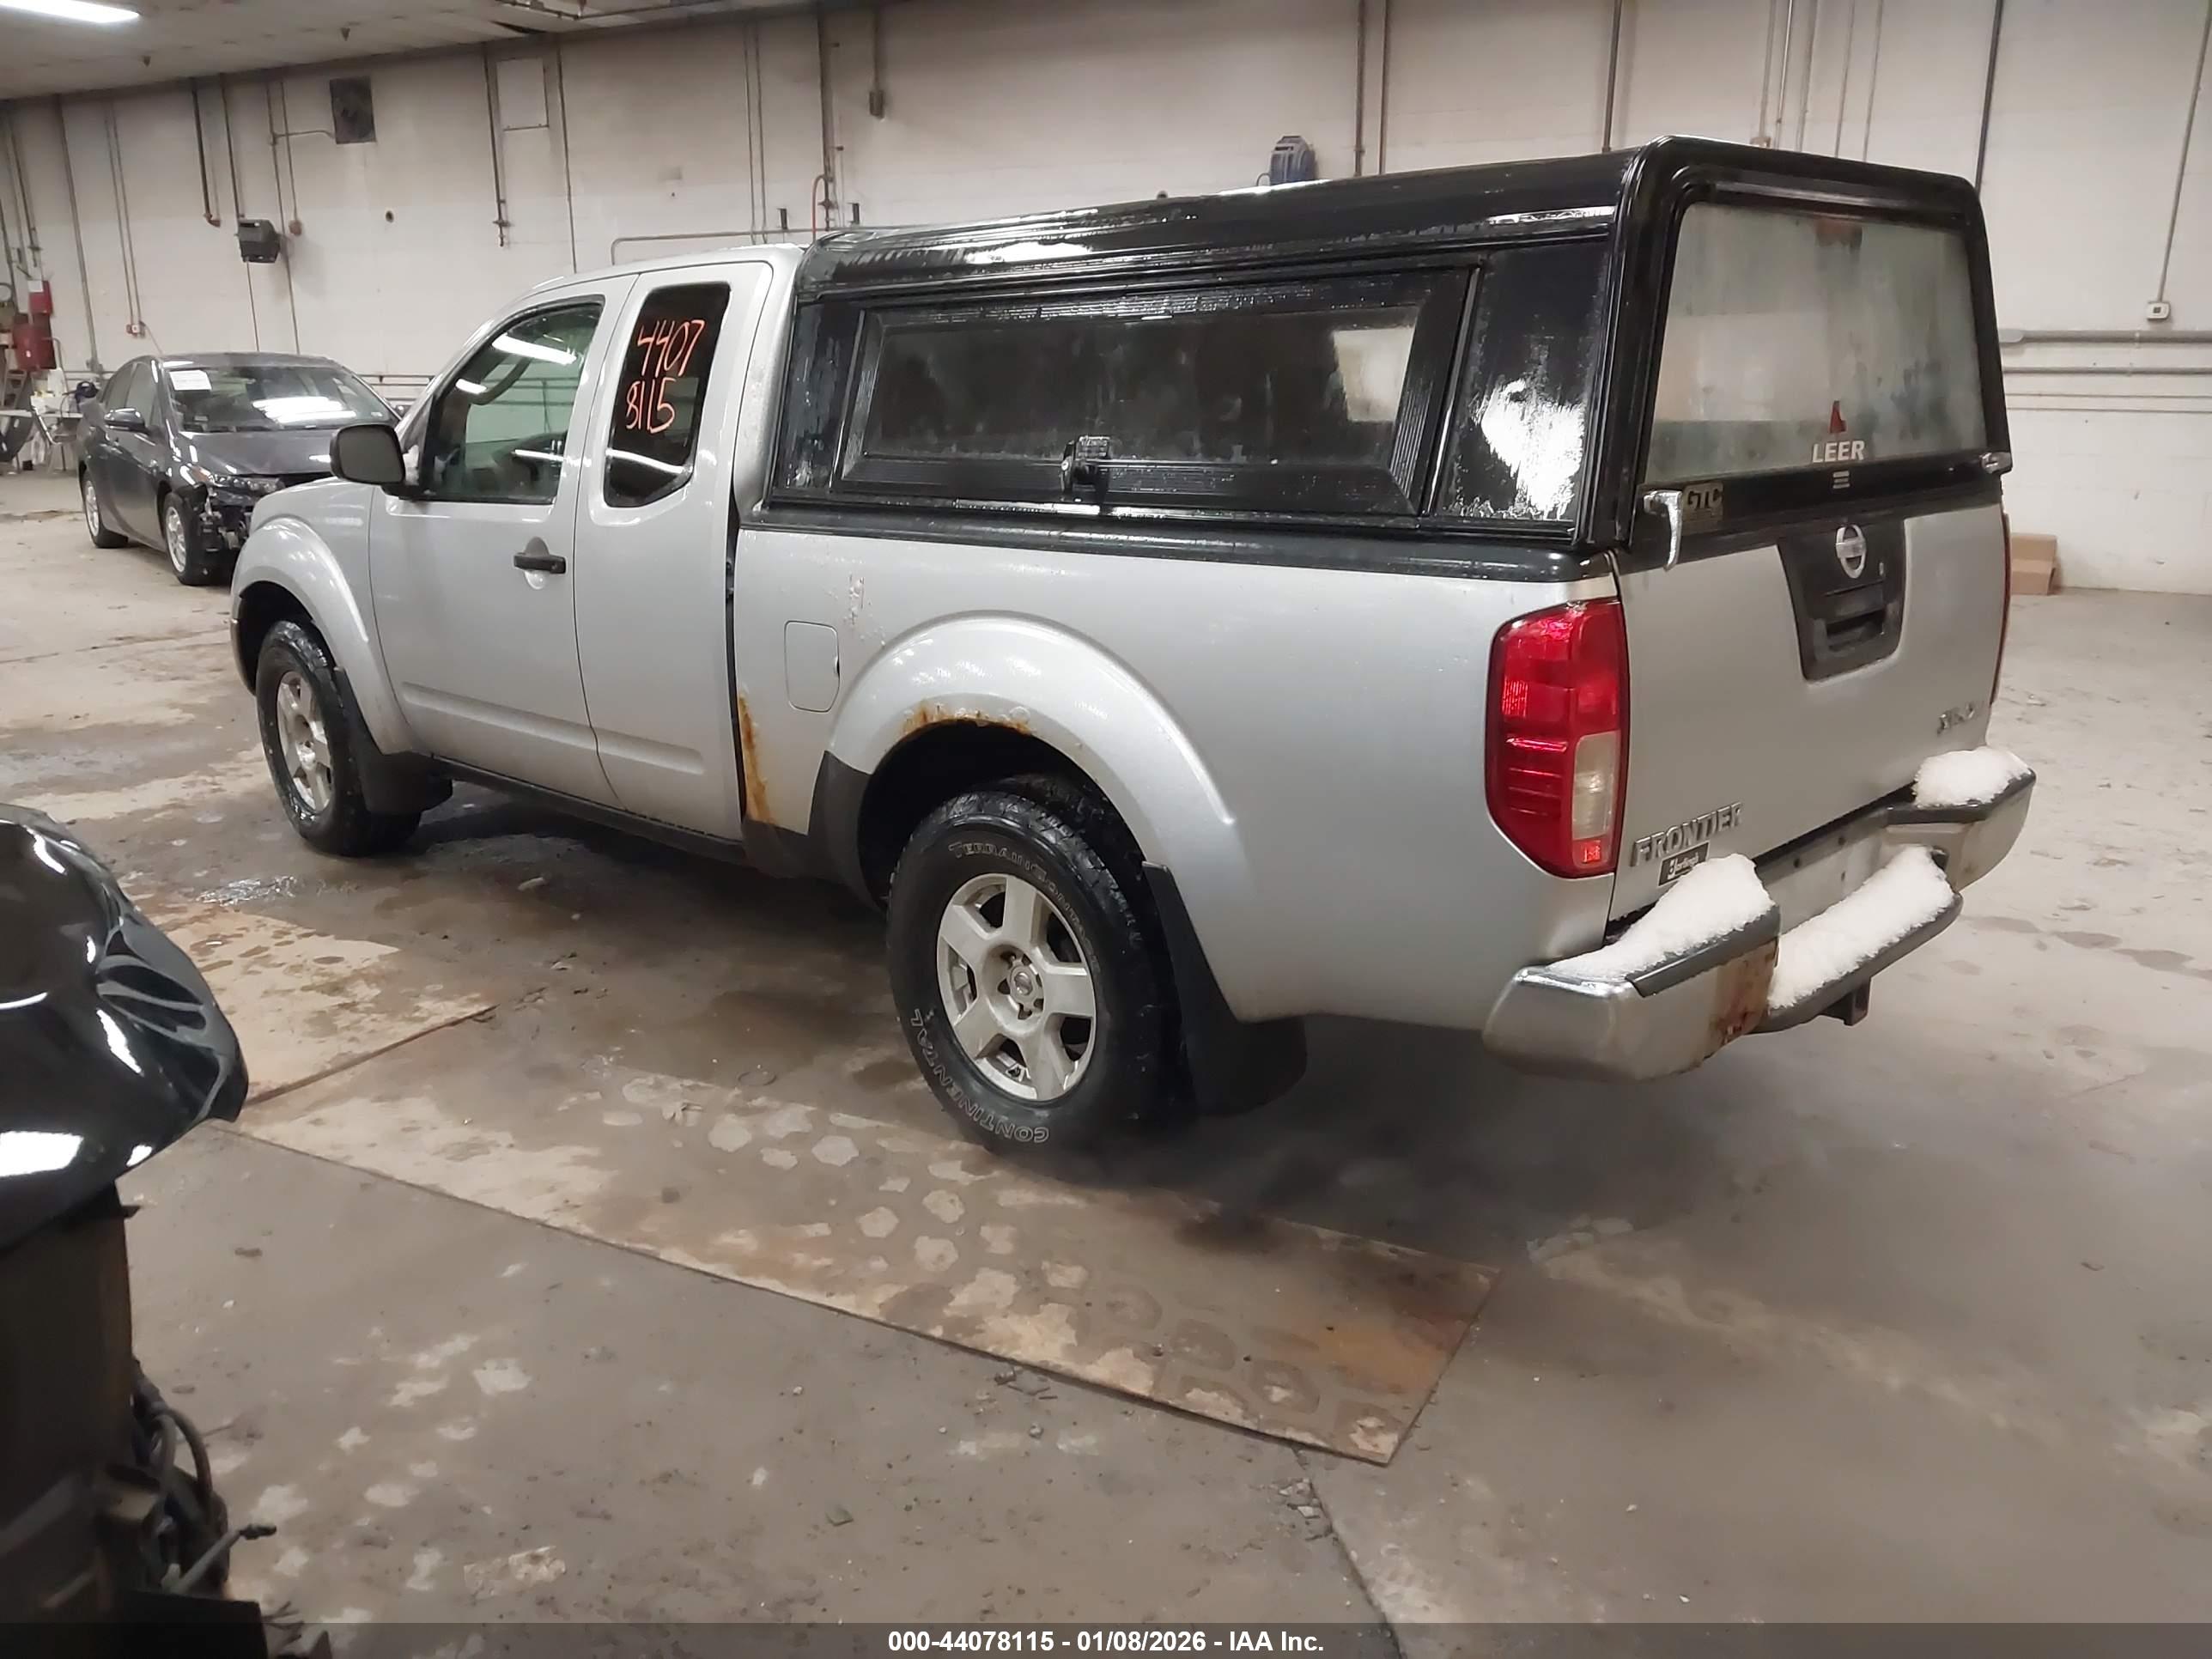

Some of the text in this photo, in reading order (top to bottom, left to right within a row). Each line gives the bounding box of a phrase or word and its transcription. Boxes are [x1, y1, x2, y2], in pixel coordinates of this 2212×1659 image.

[636, 319, 706, 379] 4407
[625, 377, 677, 434] 8115
[1812, 440, 1865, 464] LEER
[1630, 800, 1744, 868] FRONTIER
[910, 1008, 1049, 1144] CONTINENTAL
